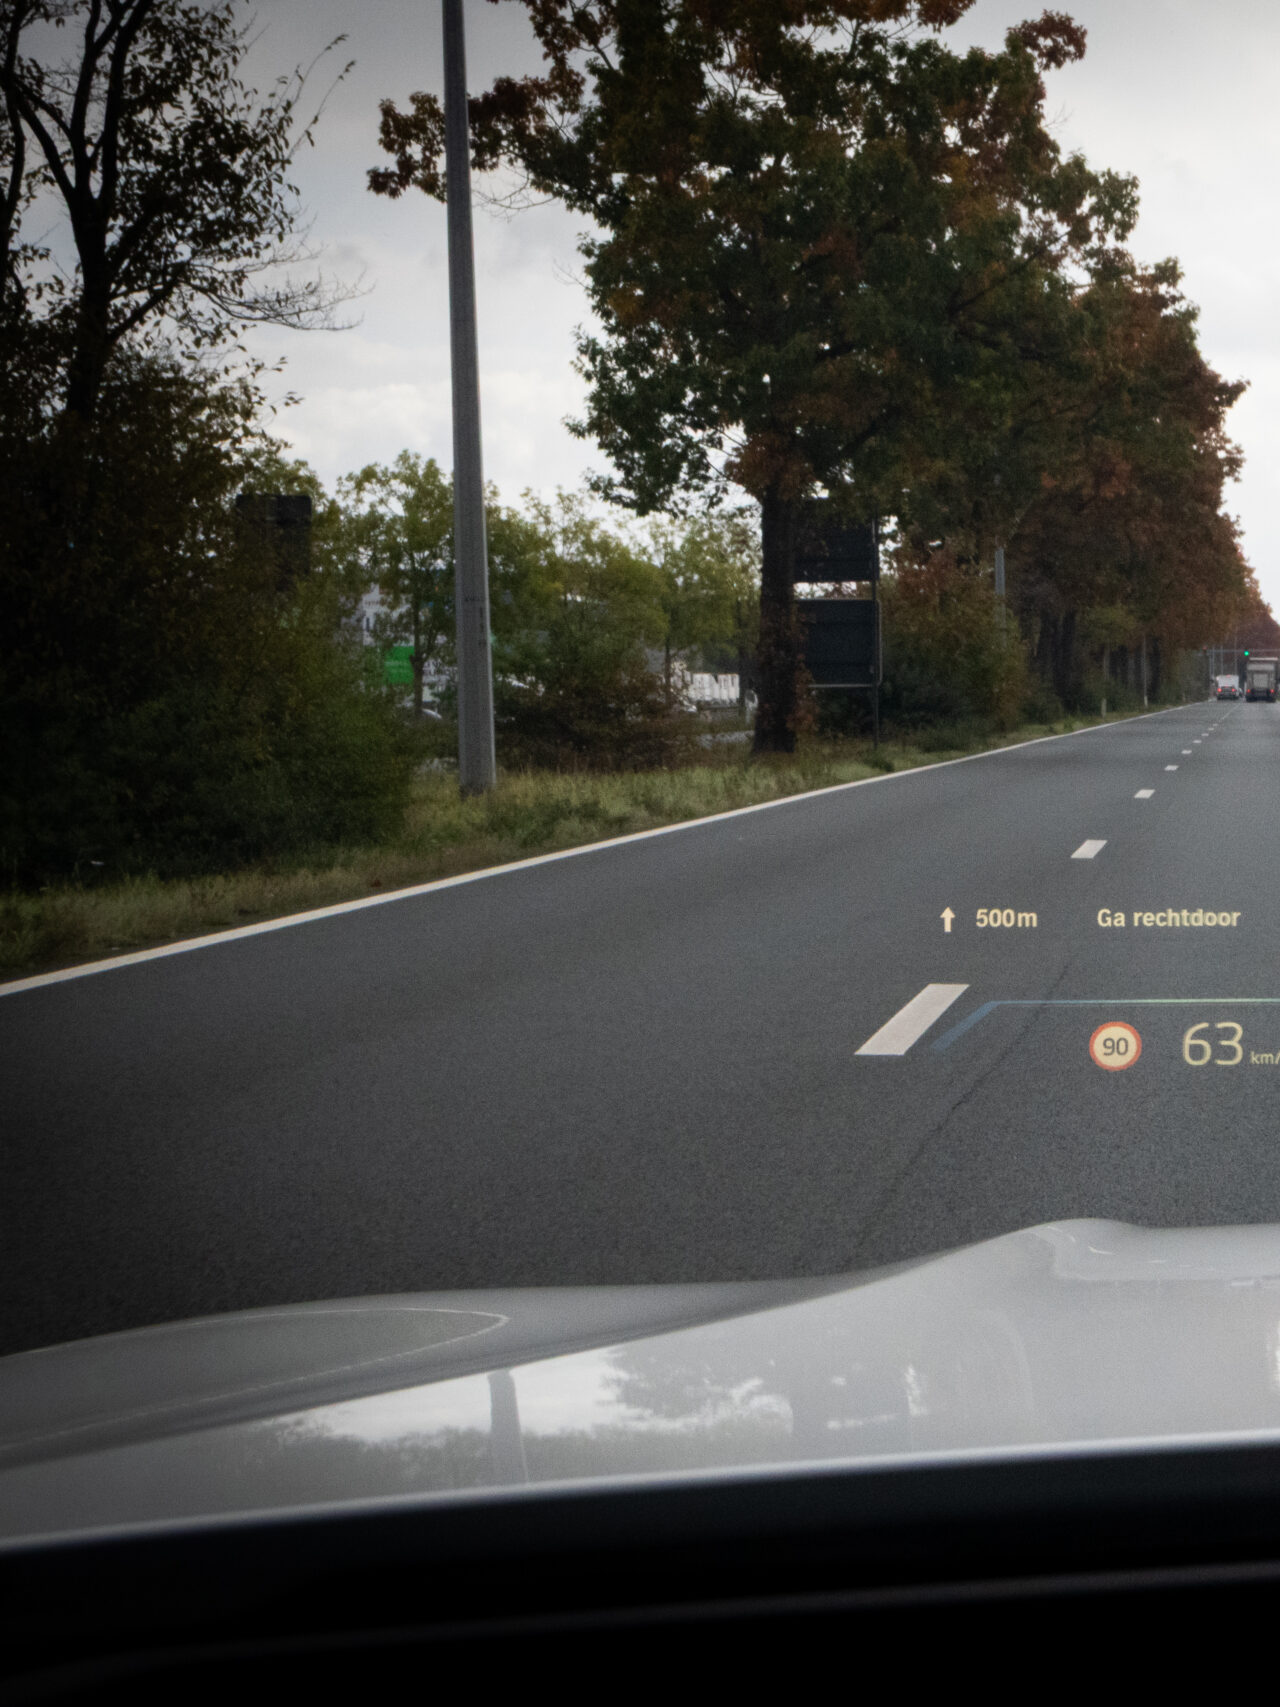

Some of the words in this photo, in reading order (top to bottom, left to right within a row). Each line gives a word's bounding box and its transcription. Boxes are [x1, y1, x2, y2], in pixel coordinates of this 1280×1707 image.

[975, 909, 1038, 928] 500m
[1097, 908, 1126, 928] Ga
[1133, 908, 1241, 927] rechtdoor
[1102, 1037, 1129, 1057] 90
[1182, 1021, 1244, 1066] 63
